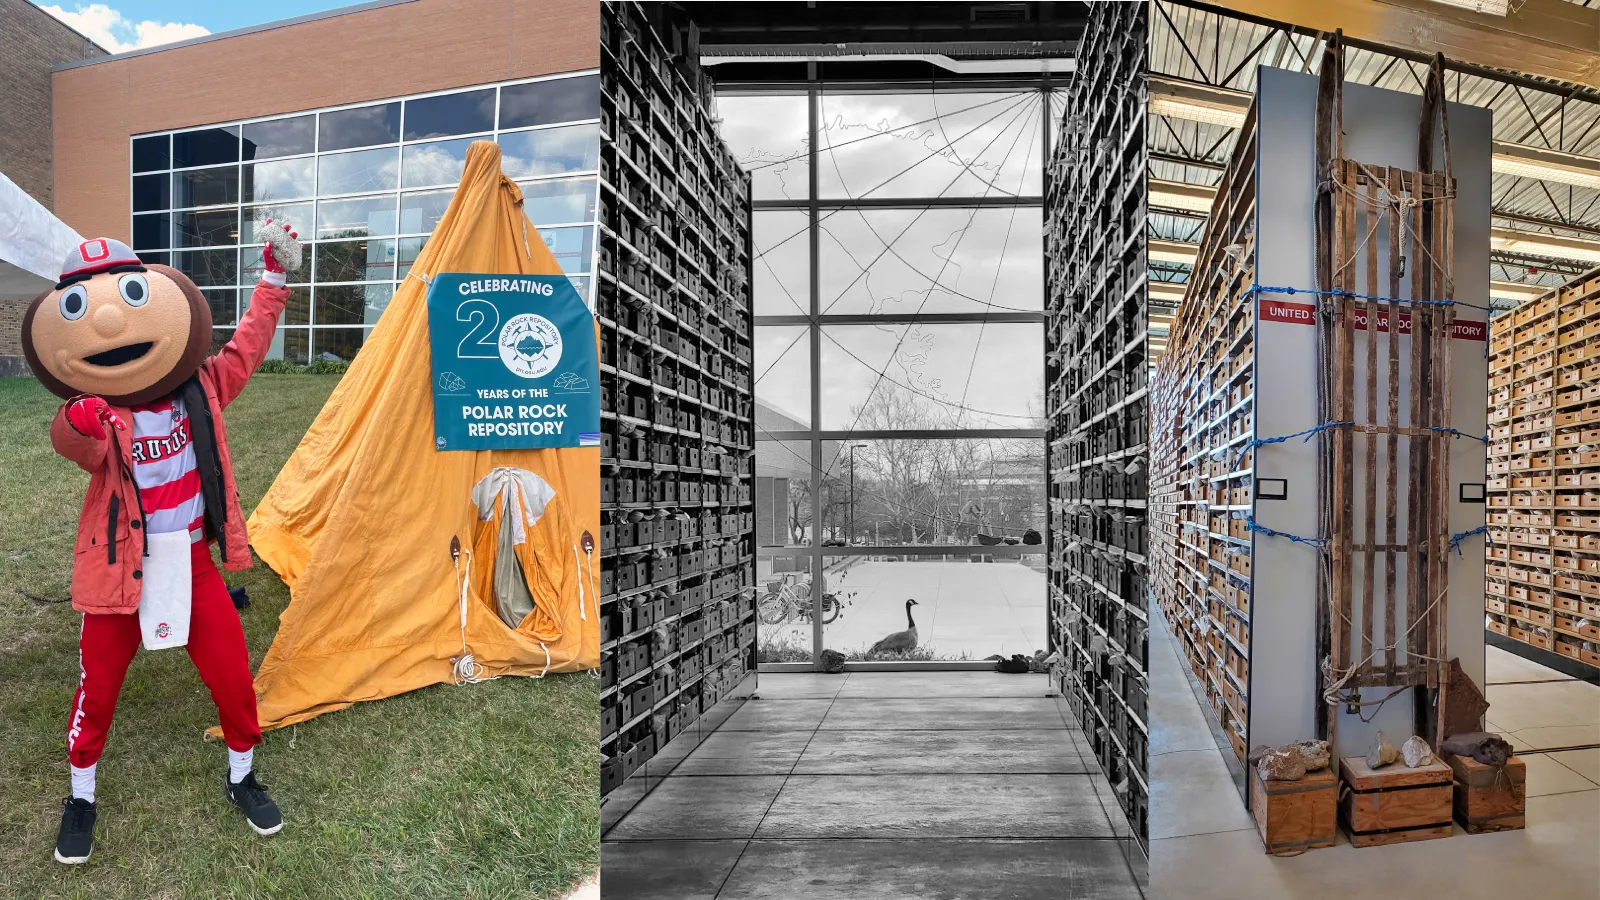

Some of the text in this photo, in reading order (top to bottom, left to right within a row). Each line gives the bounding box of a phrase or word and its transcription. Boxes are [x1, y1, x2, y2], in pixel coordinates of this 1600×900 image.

[79, 239, 111, 263] O
[458, 279, 554, 297] CELEBRATING
[1269, 306, 1309, 320] UNITED
[1355, 315, 1389, 327] POAR
[502, 316, 559, 346] POLAR ROCK REPOSITORY
[476, 388, 549, 399] YEARS OF THE
[462, 403, 568, 420] POLAR ROCK
[468, 421, 564, 437] REPOSITORY
[132, 424, 188, 462] RUTUS
